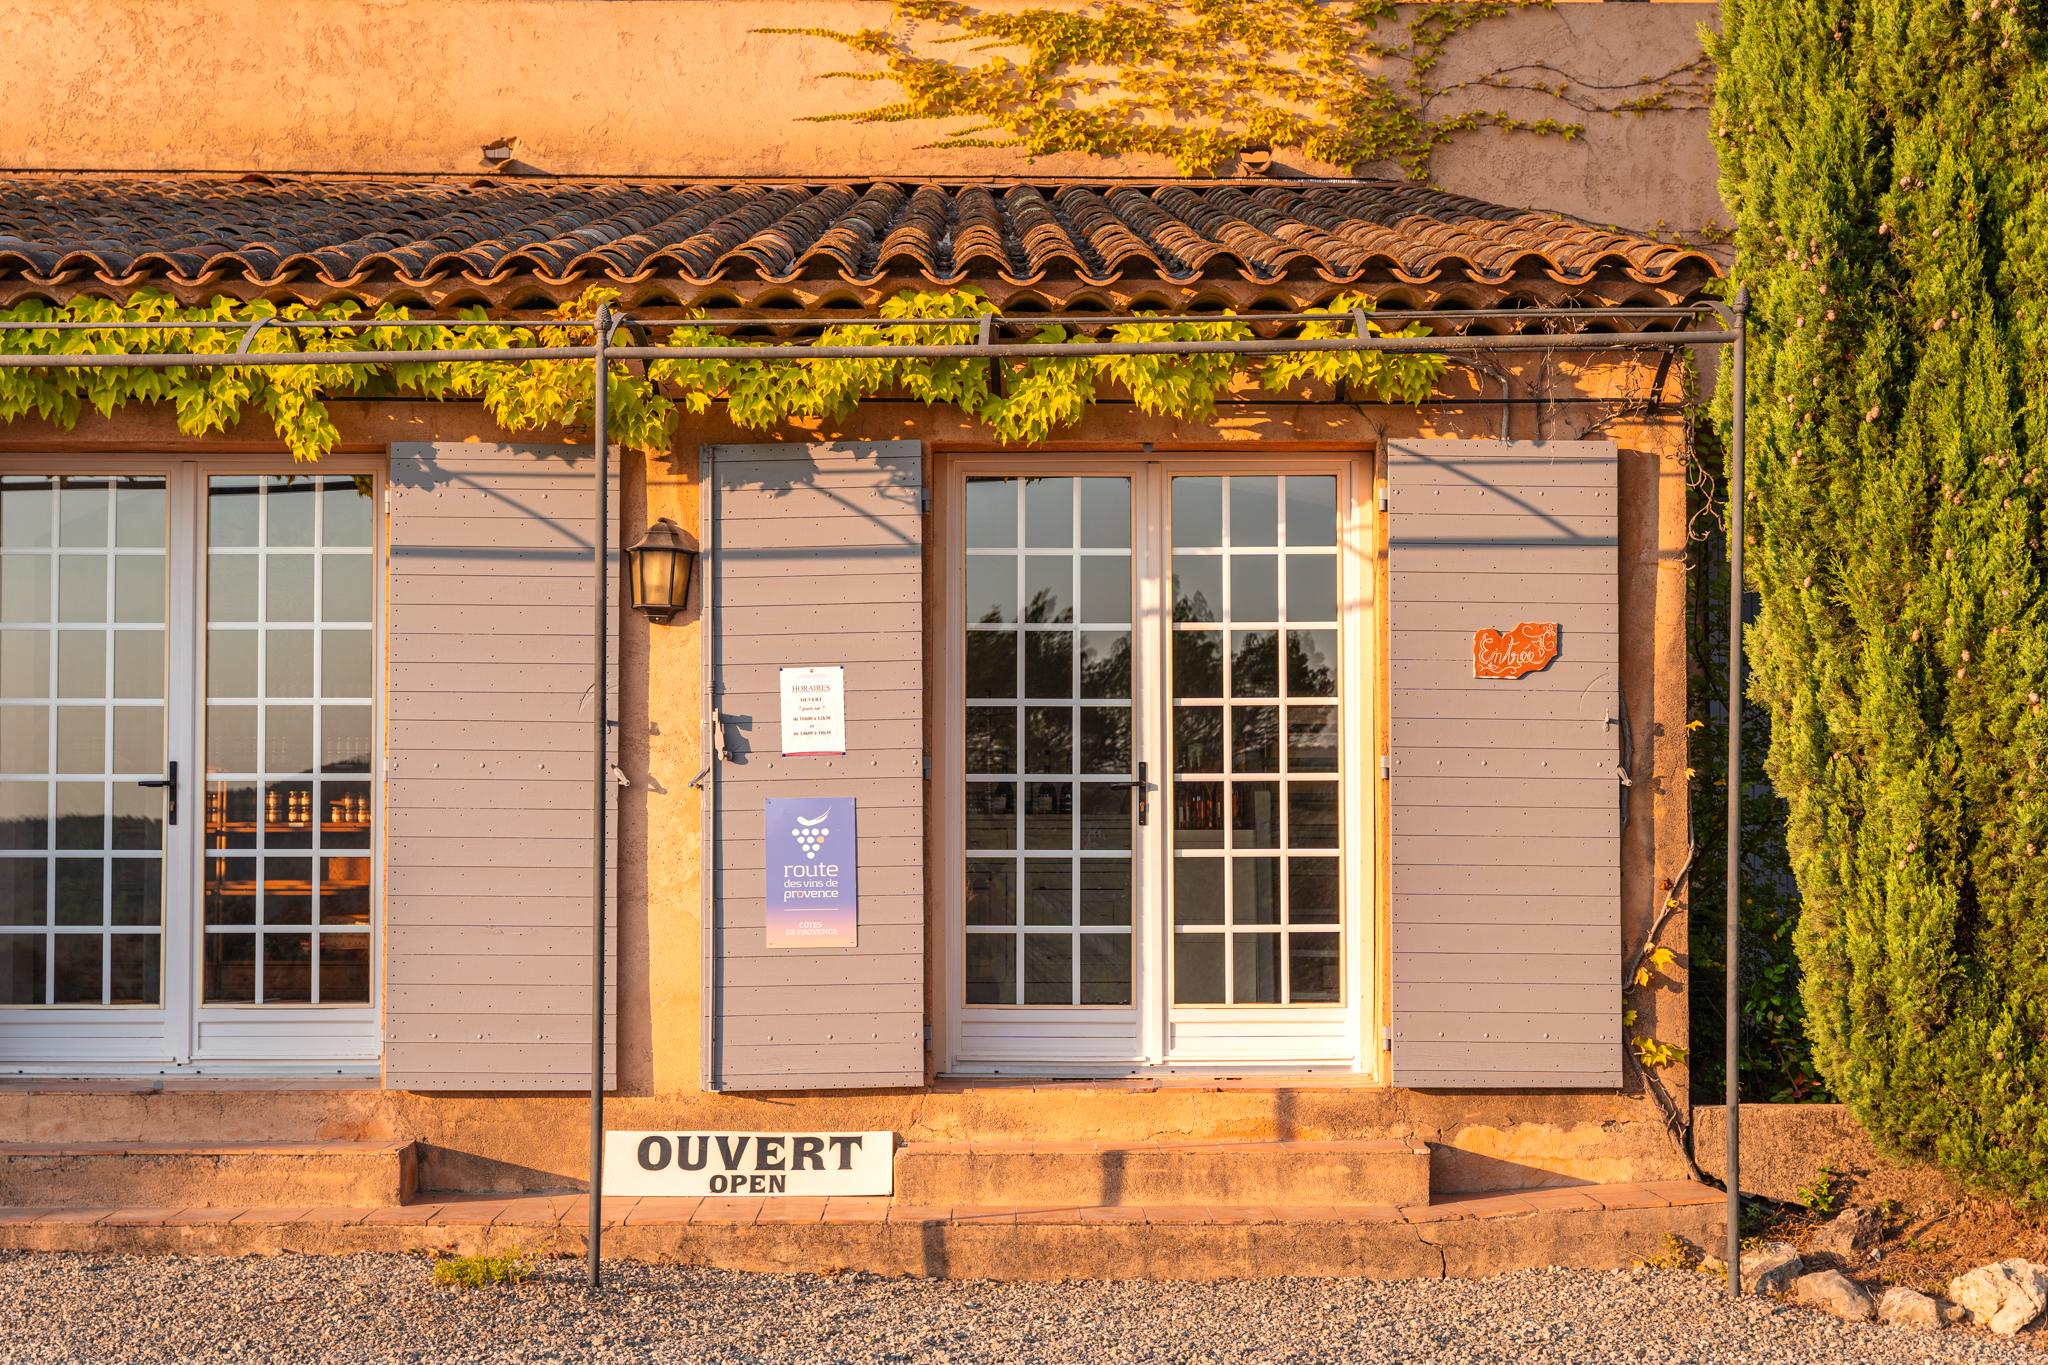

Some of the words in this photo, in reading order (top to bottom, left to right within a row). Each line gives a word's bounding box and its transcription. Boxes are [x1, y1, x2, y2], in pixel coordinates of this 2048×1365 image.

[1478, 632, 1544, 665] Entrée
[792, 684, 831, 693] HORAIRES
[784, 862, 839, 878] route
[784, 879, 802, 888] des
[803, 879, 824, 888] vins
[825, 878, 839, 887] de
[784, 890, 839, 902] provence
[637, 1135, 863, 1171] OUVERT
[709, 1174, 787, 1194] OPEN
